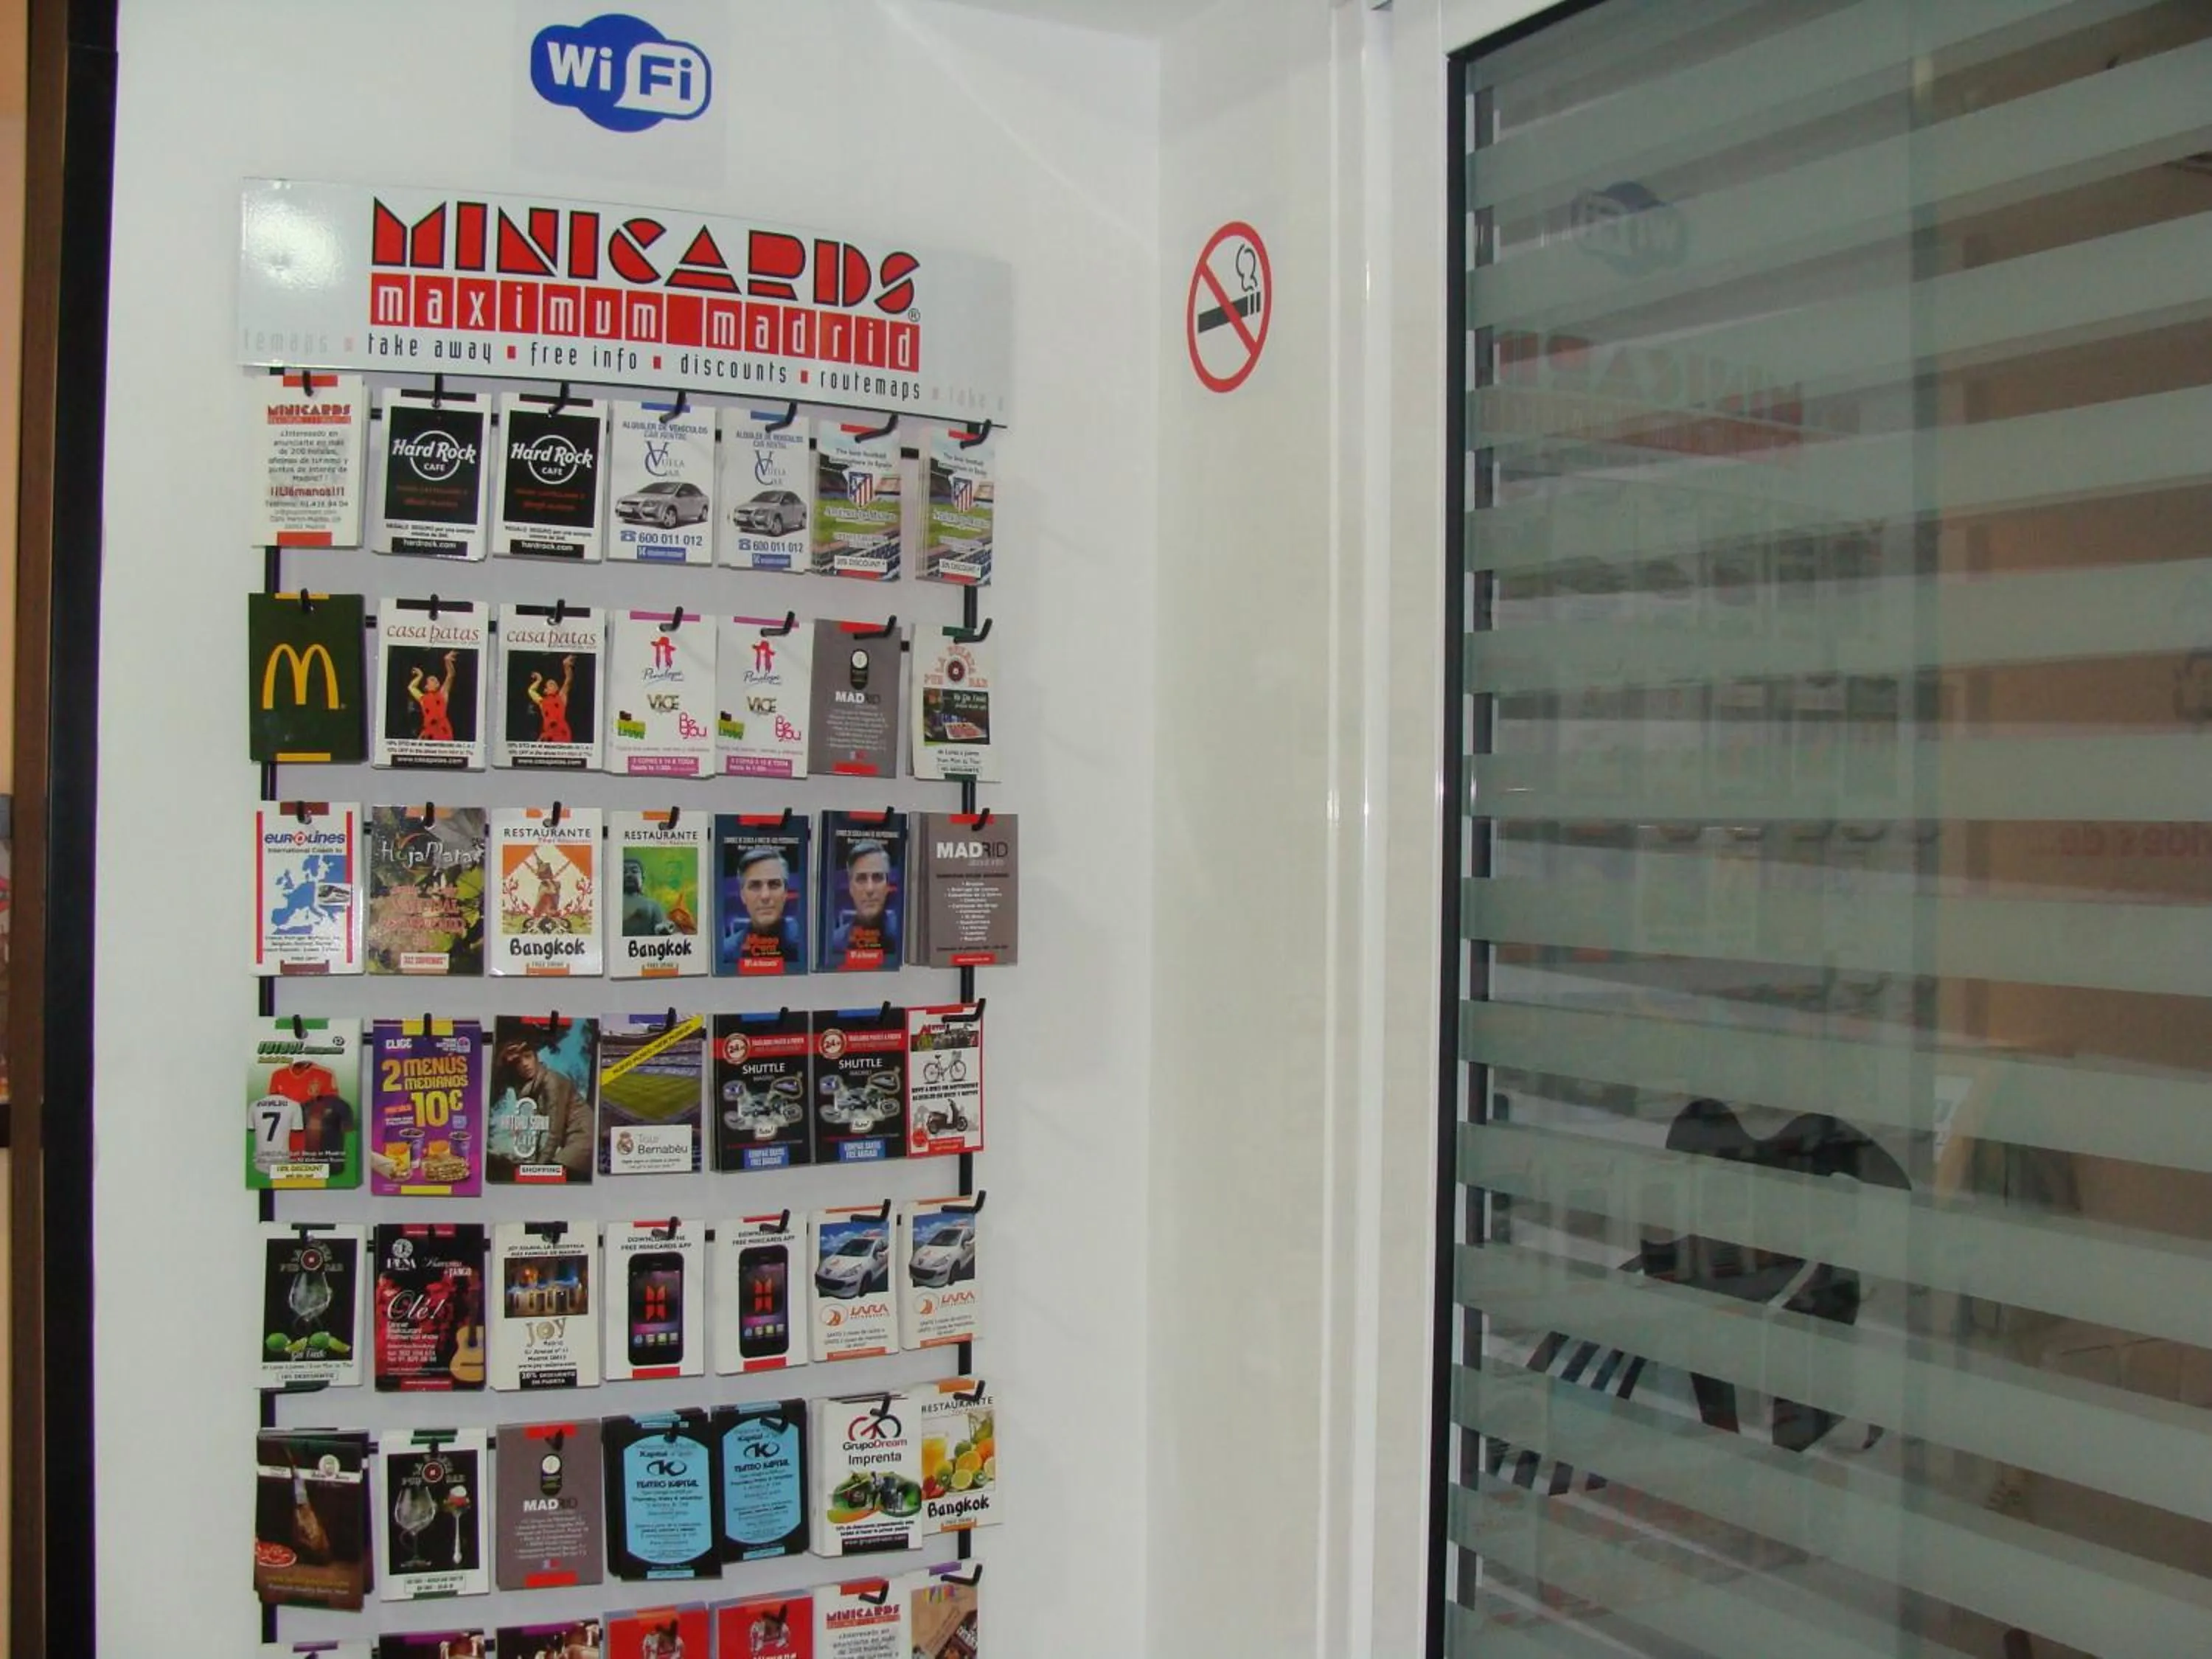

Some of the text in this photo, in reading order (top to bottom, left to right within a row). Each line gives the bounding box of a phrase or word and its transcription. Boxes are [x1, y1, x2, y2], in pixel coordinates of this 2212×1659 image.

[371, 196, 921, 316] MINICARDS
[371, 274, 921, 372] maximum madrid
[368, 333, 418, 358] take
[434, 338, 492, 365] away
[530, 341, 577, 366] free
[593, 343, 638, 372] info
[681, 352, 787, 383] discounts
[820, 369, 921, 401] routemaps
[267, 403, 352, 416] MINICARDS
[392, 439, 477, 464] Hard Rock
[511, 442, 594, 468] Hard Rock
[423, 462, 445, 471] CAFE
[541, 467, 563, 476] CAFE
[639, 530, 703, 546] 600 011 012
[753, 540, 804, 553] 600 011 012
[387, 624, 480, 643] casa patas
[507, 630, 597, 648] casa patas
[647, 694, 680, 710] VICE
[746, 696, 777, 713] VICE
[264, 830, 346, 846] eurolines
[504, 827, 591, 838] RESTAURANTE
[625, 830, 698, 841] RESTAURANTE
[936, 841, 1009, 860] MADRID
[509, 938, 585, 959] Bangkok
[627, 939, 692, 961] Bangkok
[381, 1052, 469, 1092] 2 MENÚS
[742, 1062, 786, 1075] SHUTTLE
[838, 1058, 883, 1070] SHUTTLE
[405, 1074, 469, 1091] MEDIANOS
[411, 1088, 464, 1127] 10€
[262, 1111, 282, 1142] 7
[386, 1289, 446, 1321] Olé!
[942, 1291, 975, 1304] LARA
[849, 1304, 889, 1315] LARA
[921, 1396, 995, 1413] RESTAURANTE
[842, 1438, 908, 1451] GrupoDream
[848, 1450, 902, 1467] Imprenta
[927, 1494, 990, 1518] Bangkok
[826, 1604, 901, 1622] MINICARDS
